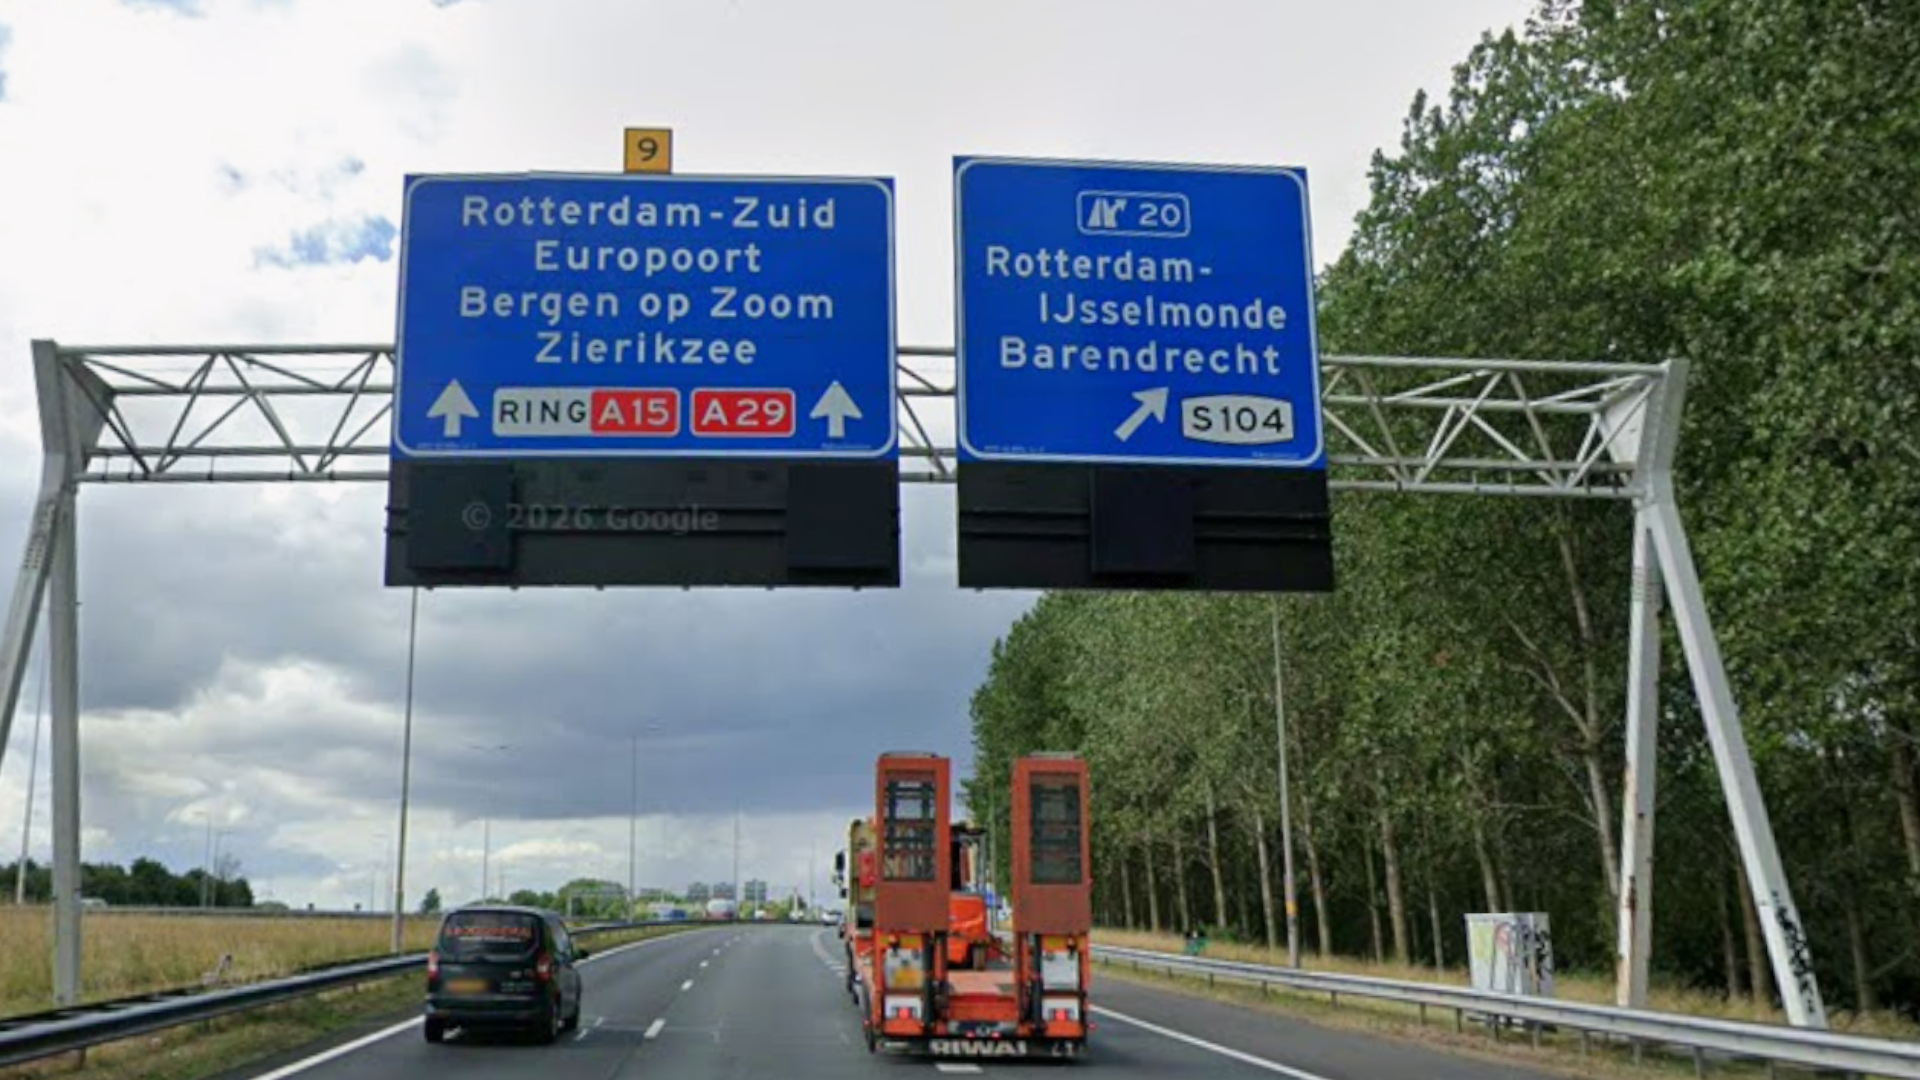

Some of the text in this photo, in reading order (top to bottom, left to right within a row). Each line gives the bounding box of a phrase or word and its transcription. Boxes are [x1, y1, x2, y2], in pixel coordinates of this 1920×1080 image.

[636, 137, 659, 162] 9
[462, 196, 836, 229] Rotterdam-Zuid
[1138, 203, 1181, 227] 20
[535, 241, 762, 276] Europoort
[986, 246, 1212, 282] Rotterdam-
[460, 287, 834, 325] Bergen op Zoom
[1039, 293, 1287, 330] IJsselmonde
[535, 332, 757, 364] Zierikzee
[1000, 337, 1280, 375] Barendrecht
[500, 399, 670, 425] RING A15
[701, 399, 787, 425] A29
[1192, 406, 1285, 434] S104
